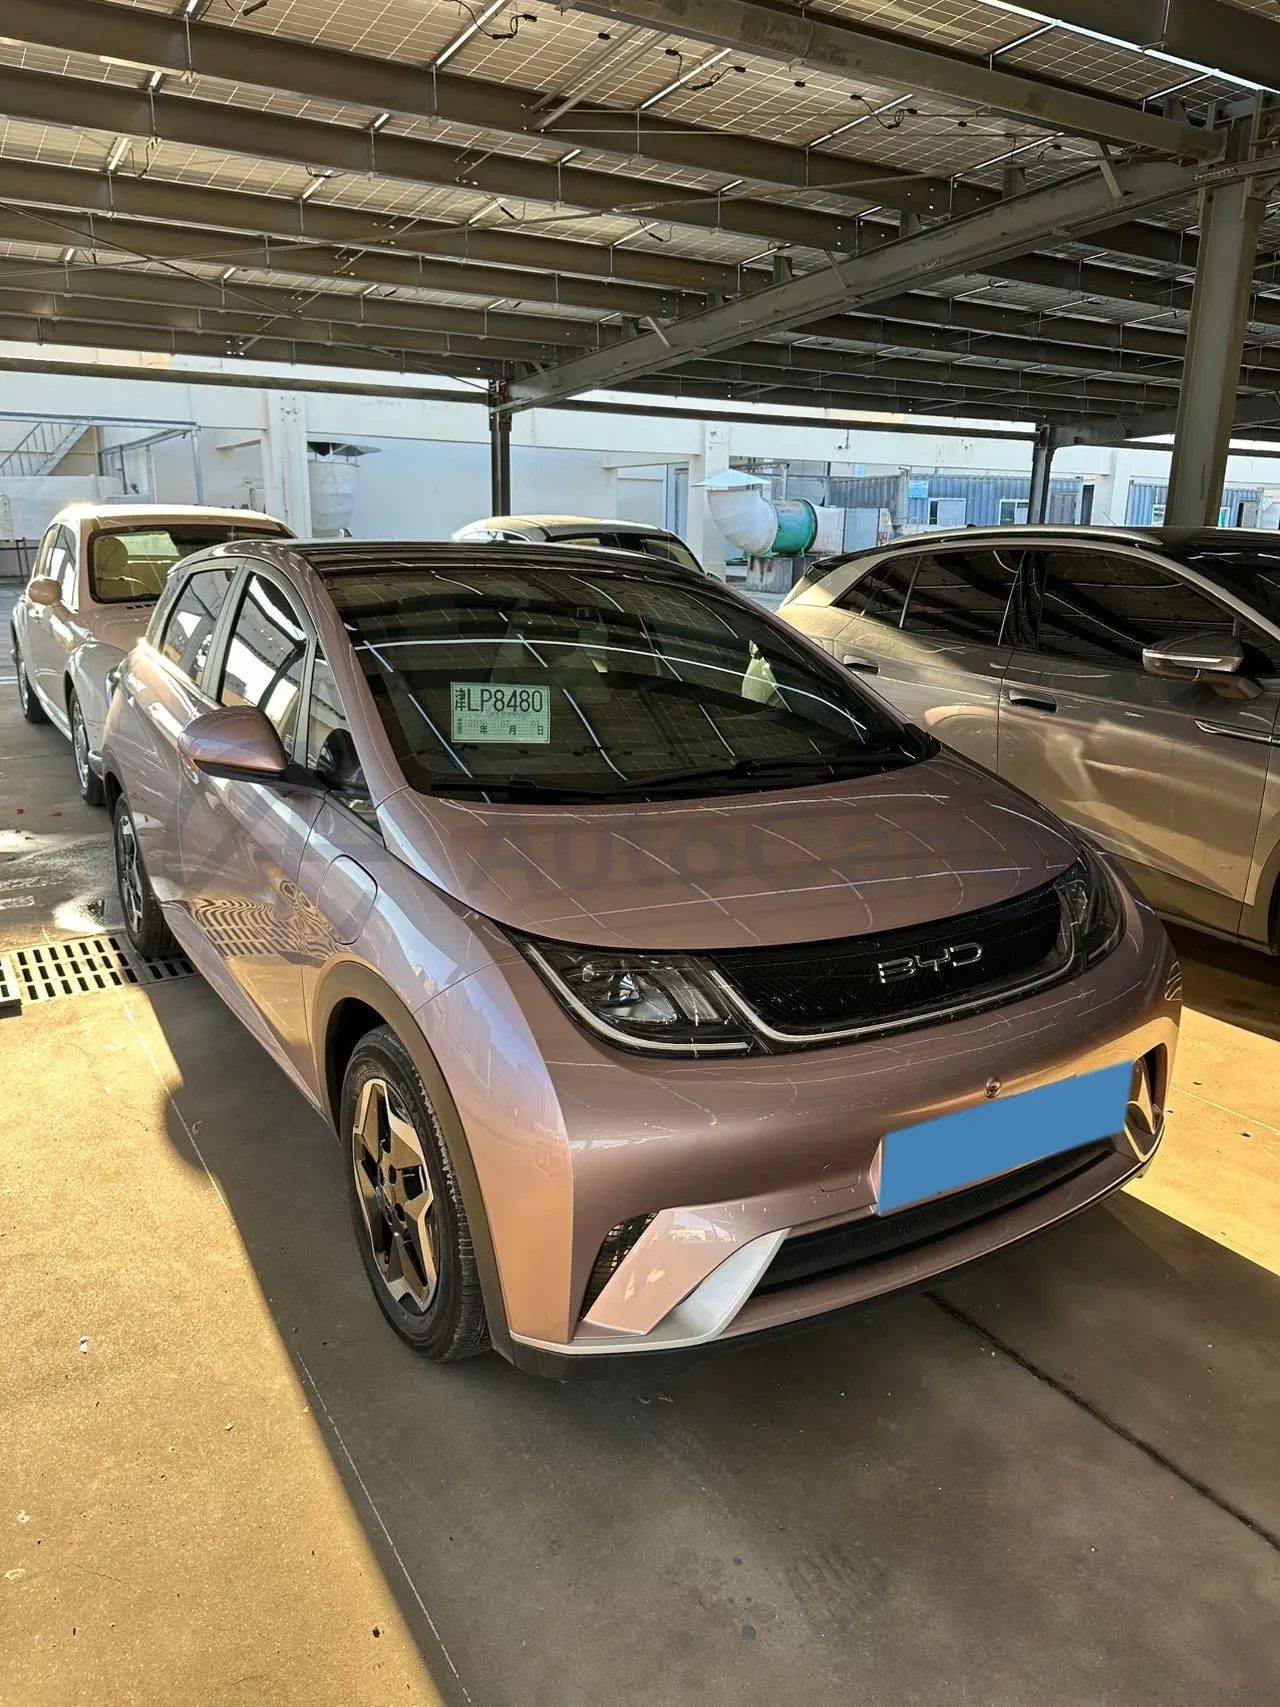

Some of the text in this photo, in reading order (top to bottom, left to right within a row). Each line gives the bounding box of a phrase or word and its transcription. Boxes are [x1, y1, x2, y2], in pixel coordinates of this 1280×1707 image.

[509, 725, 516, 735] 月
[537, 725, 543, 735] 日
[878, 942, 982, 983] BYD
